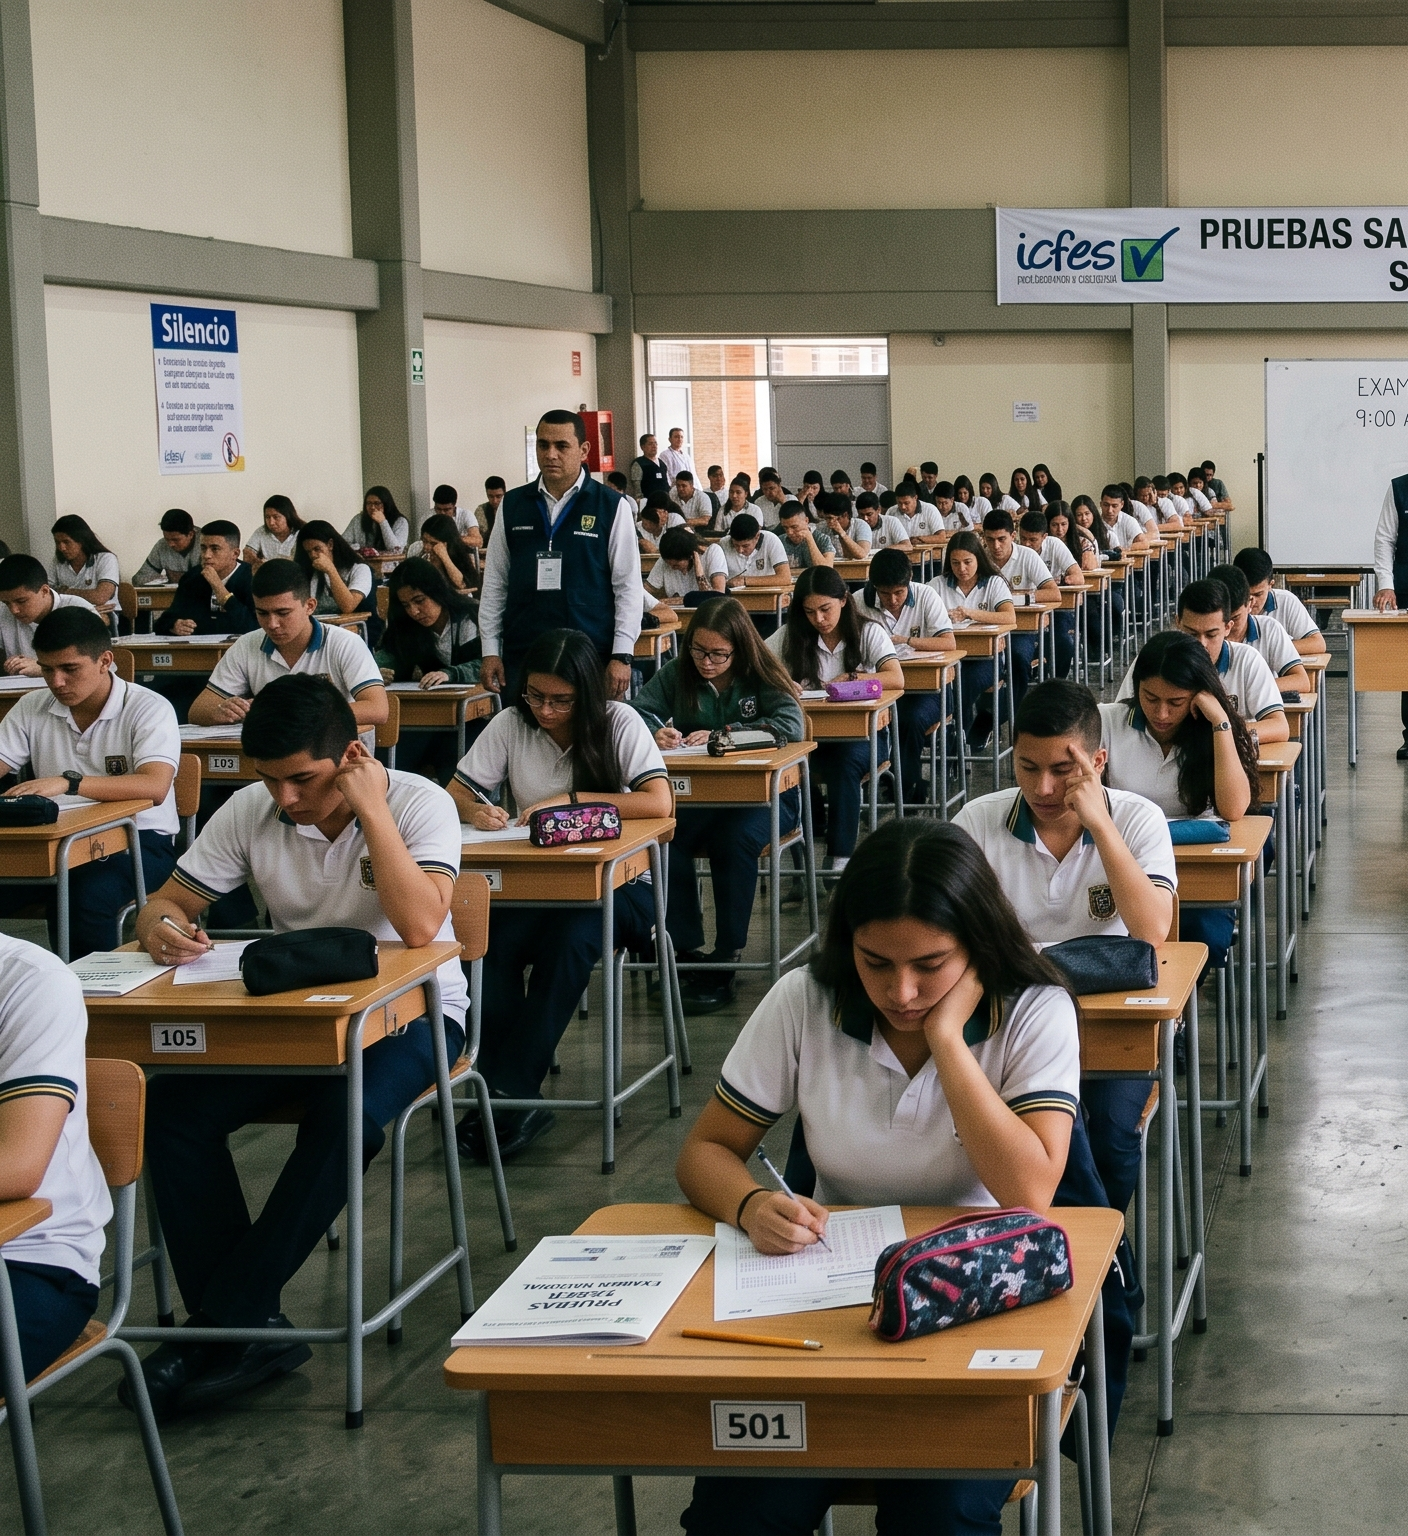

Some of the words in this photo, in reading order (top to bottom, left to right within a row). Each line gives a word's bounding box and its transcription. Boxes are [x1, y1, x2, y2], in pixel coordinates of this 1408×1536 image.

[1200, 218, 1352, 249] PRUEBAS
[1017, 229, 1116, 272] icfes
[161, 313, 230, 346] Silencio
[1356, 409, 1396, 427] 9:00
[161, 1029, 197, 1046] 105
[728, 1413, 791, 1439] 501
